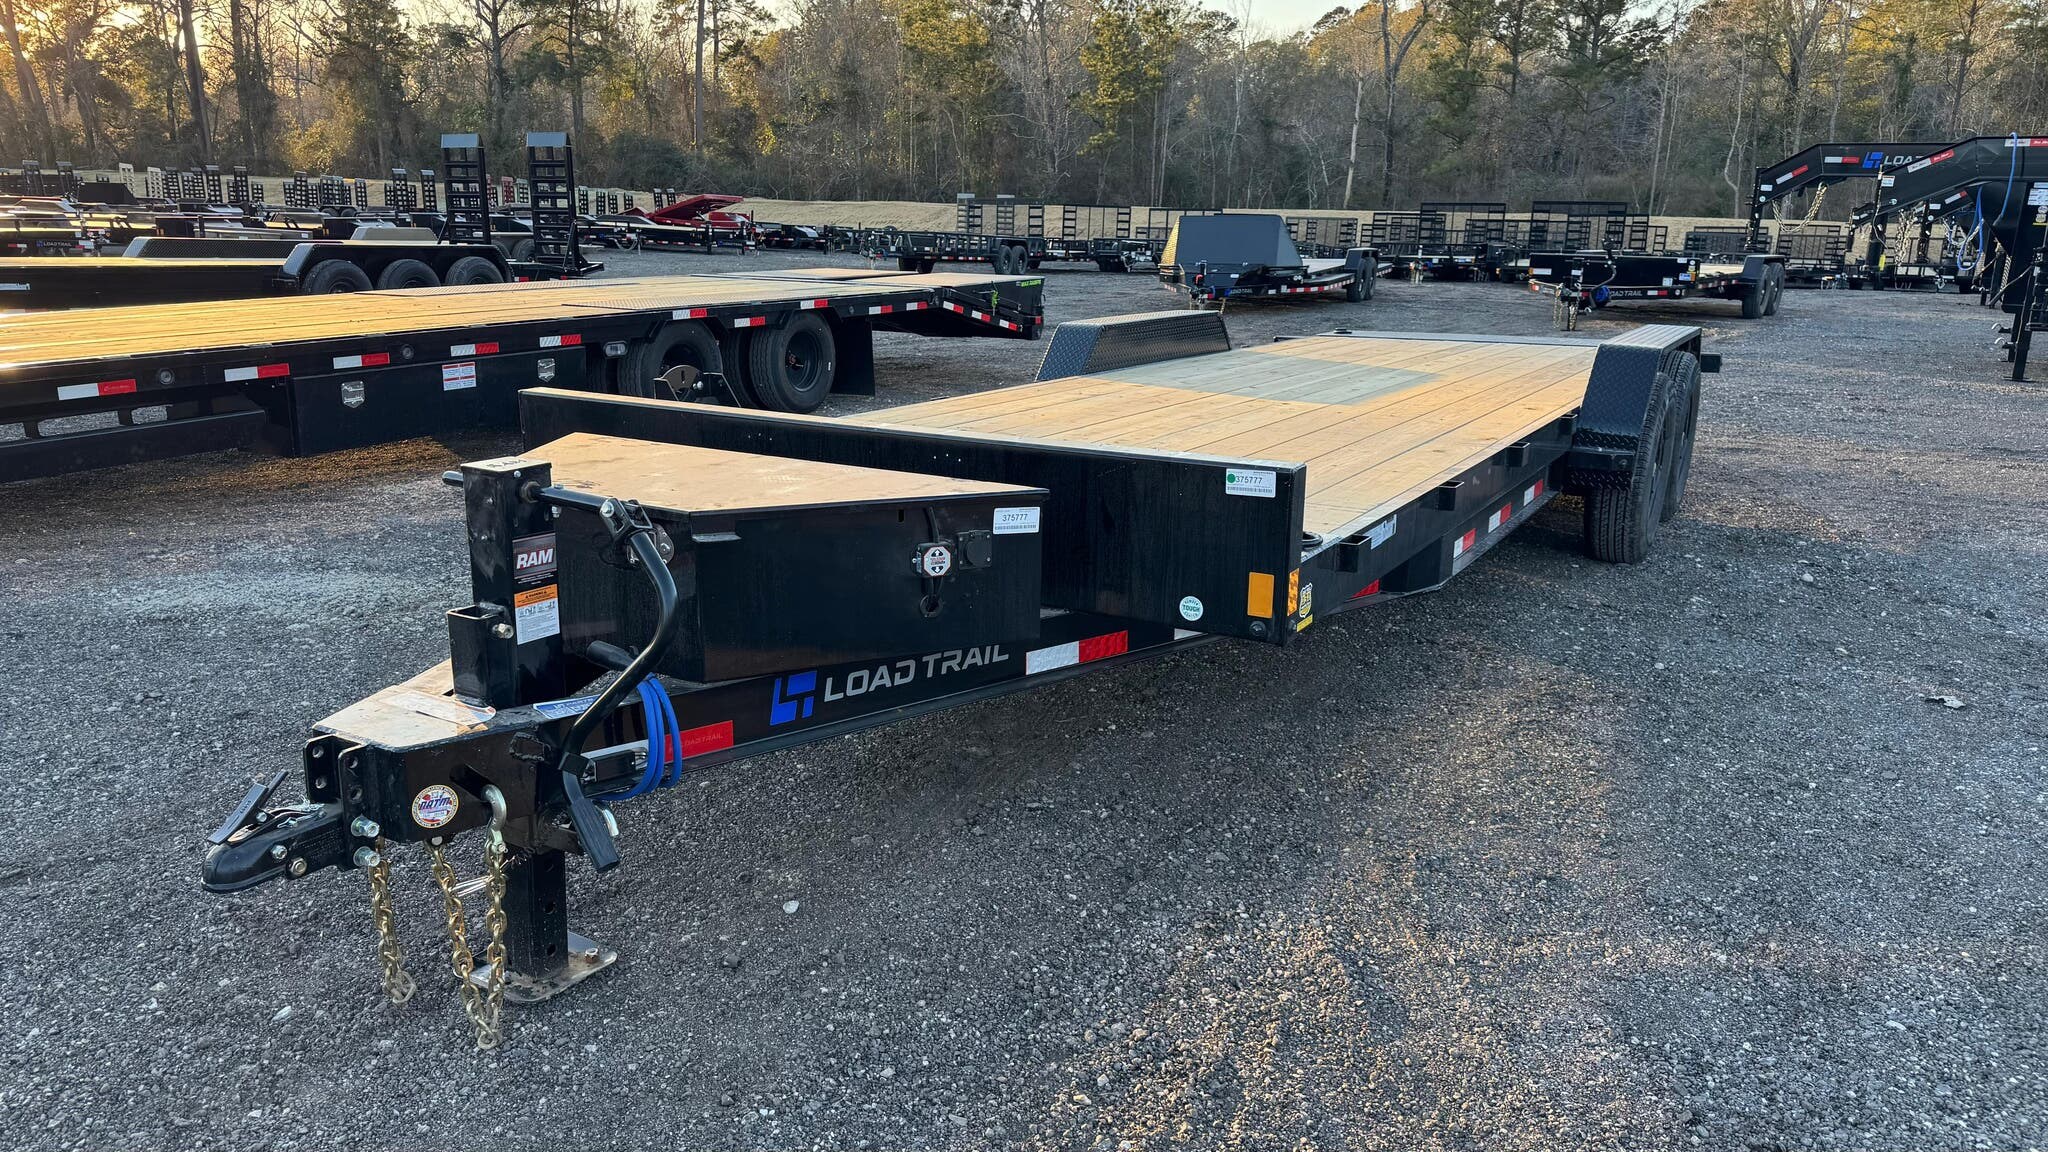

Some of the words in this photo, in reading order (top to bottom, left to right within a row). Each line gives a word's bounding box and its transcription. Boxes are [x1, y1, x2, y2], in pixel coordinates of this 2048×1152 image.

[1884, 155, 1924, 165] LOA
[1235, 475, 1263, 485] 375777
[1002, 513, 1028, 522] 375777
[516, 548, 554, 570] RAM
[823, 659, 917, 703] LOAD
[922, 644, 1010, 679] TRAIL
